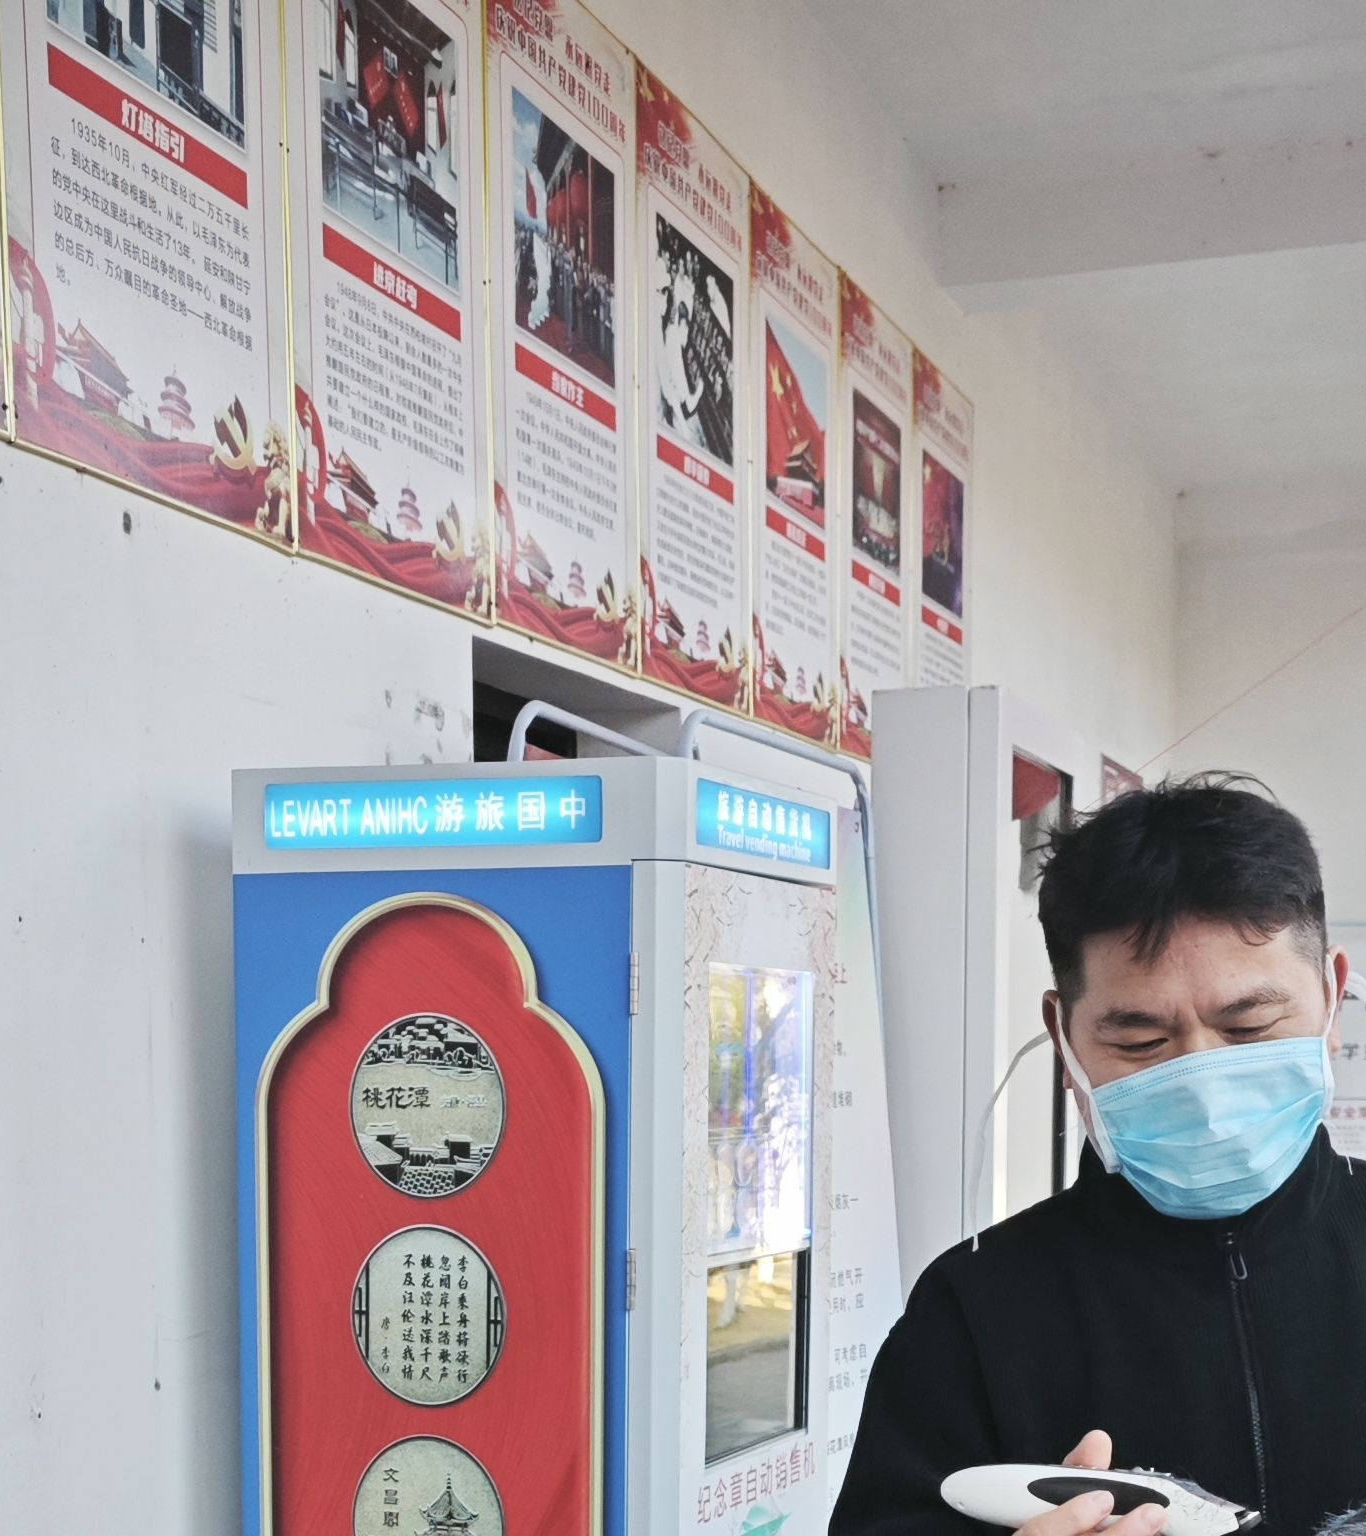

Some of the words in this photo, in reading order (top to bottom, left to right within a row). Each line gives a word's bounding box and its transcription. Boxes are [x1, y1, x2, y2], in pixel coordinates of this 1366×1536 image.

[121, 98, 185, 163] 灯塔指引
[270, 799, 351, 838] LEVART
[360, 796, 428, 836] ANIHC
[718, 824, 745, 848] Travel
[745, 828, 777, 860] vending
[778, 841, 812, 872] machine
[362, 1086, 431, 1109] 桃花潭
[401, 1253, 415, 1381] 不及汪伦送我情
[419, 1254, 435, 1381] 桃花潭水深千尺
[455, 1255, 470, 1383] 李白乘舟将欲行
[697, 1441, 816, 1525] 纪念章自动销售机
